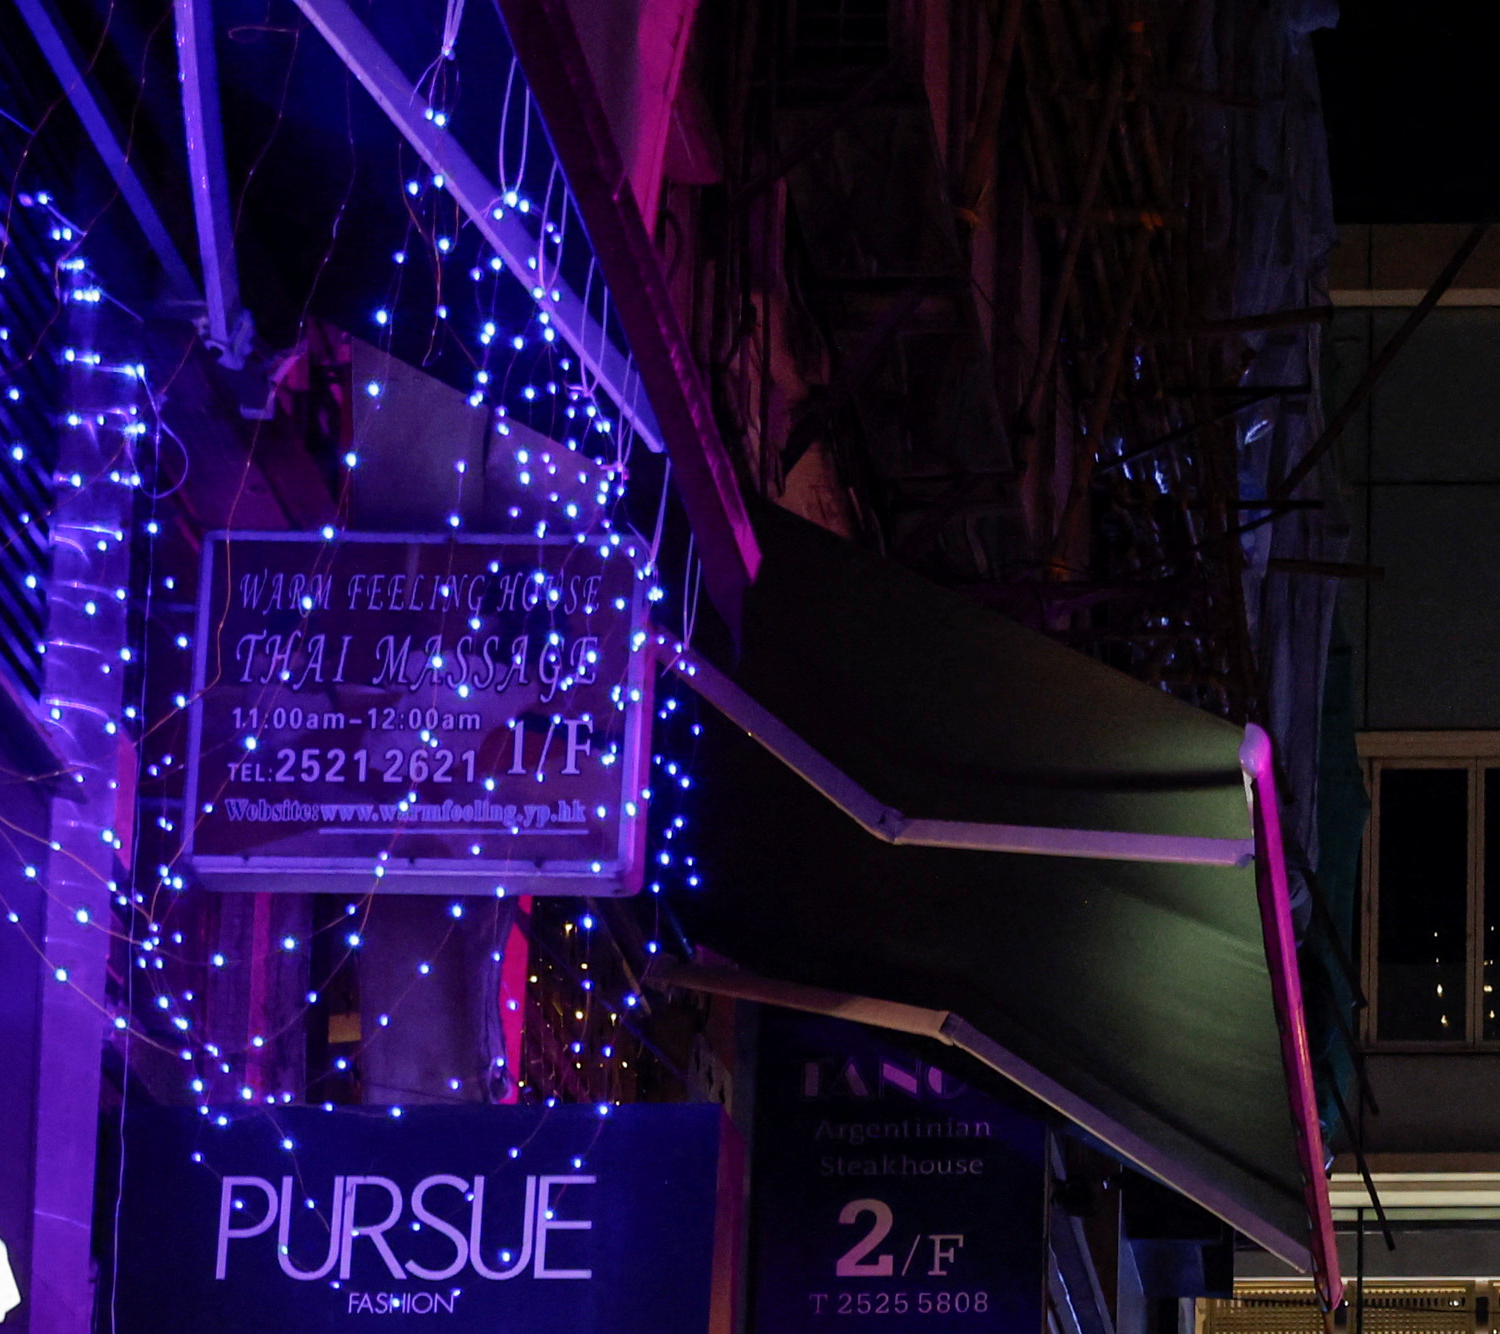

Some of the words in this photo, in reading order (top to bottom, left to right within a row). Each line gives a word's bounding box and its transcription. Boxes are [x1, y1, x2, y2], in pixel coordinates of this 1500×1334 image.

[239, 570, 332, 615] WARM
[348, 573, 486, 616] FEELING
[498, 572, 603, 615] HOUSE
[235, 629, 352, 692] THAI
[372, 633, 600, 704] MASSAGE
[383, 748, 477, 784] 2621
[506, 717, 594, 777] 1/F
[814, 1118, 992, 1146] Argentinian
[819, 1153, 984, 1177] Steakhouse
[215, 1174, 597, 1281] PURSUE
[835, 1198, 965, 1278] 2/F
[347, 1292, 455, 1315] FASHION
[810, 1293, 828, 1315] T
[837, 1292, 910, 1315] 2525
[917, 1291, 989, 1315] 5808
